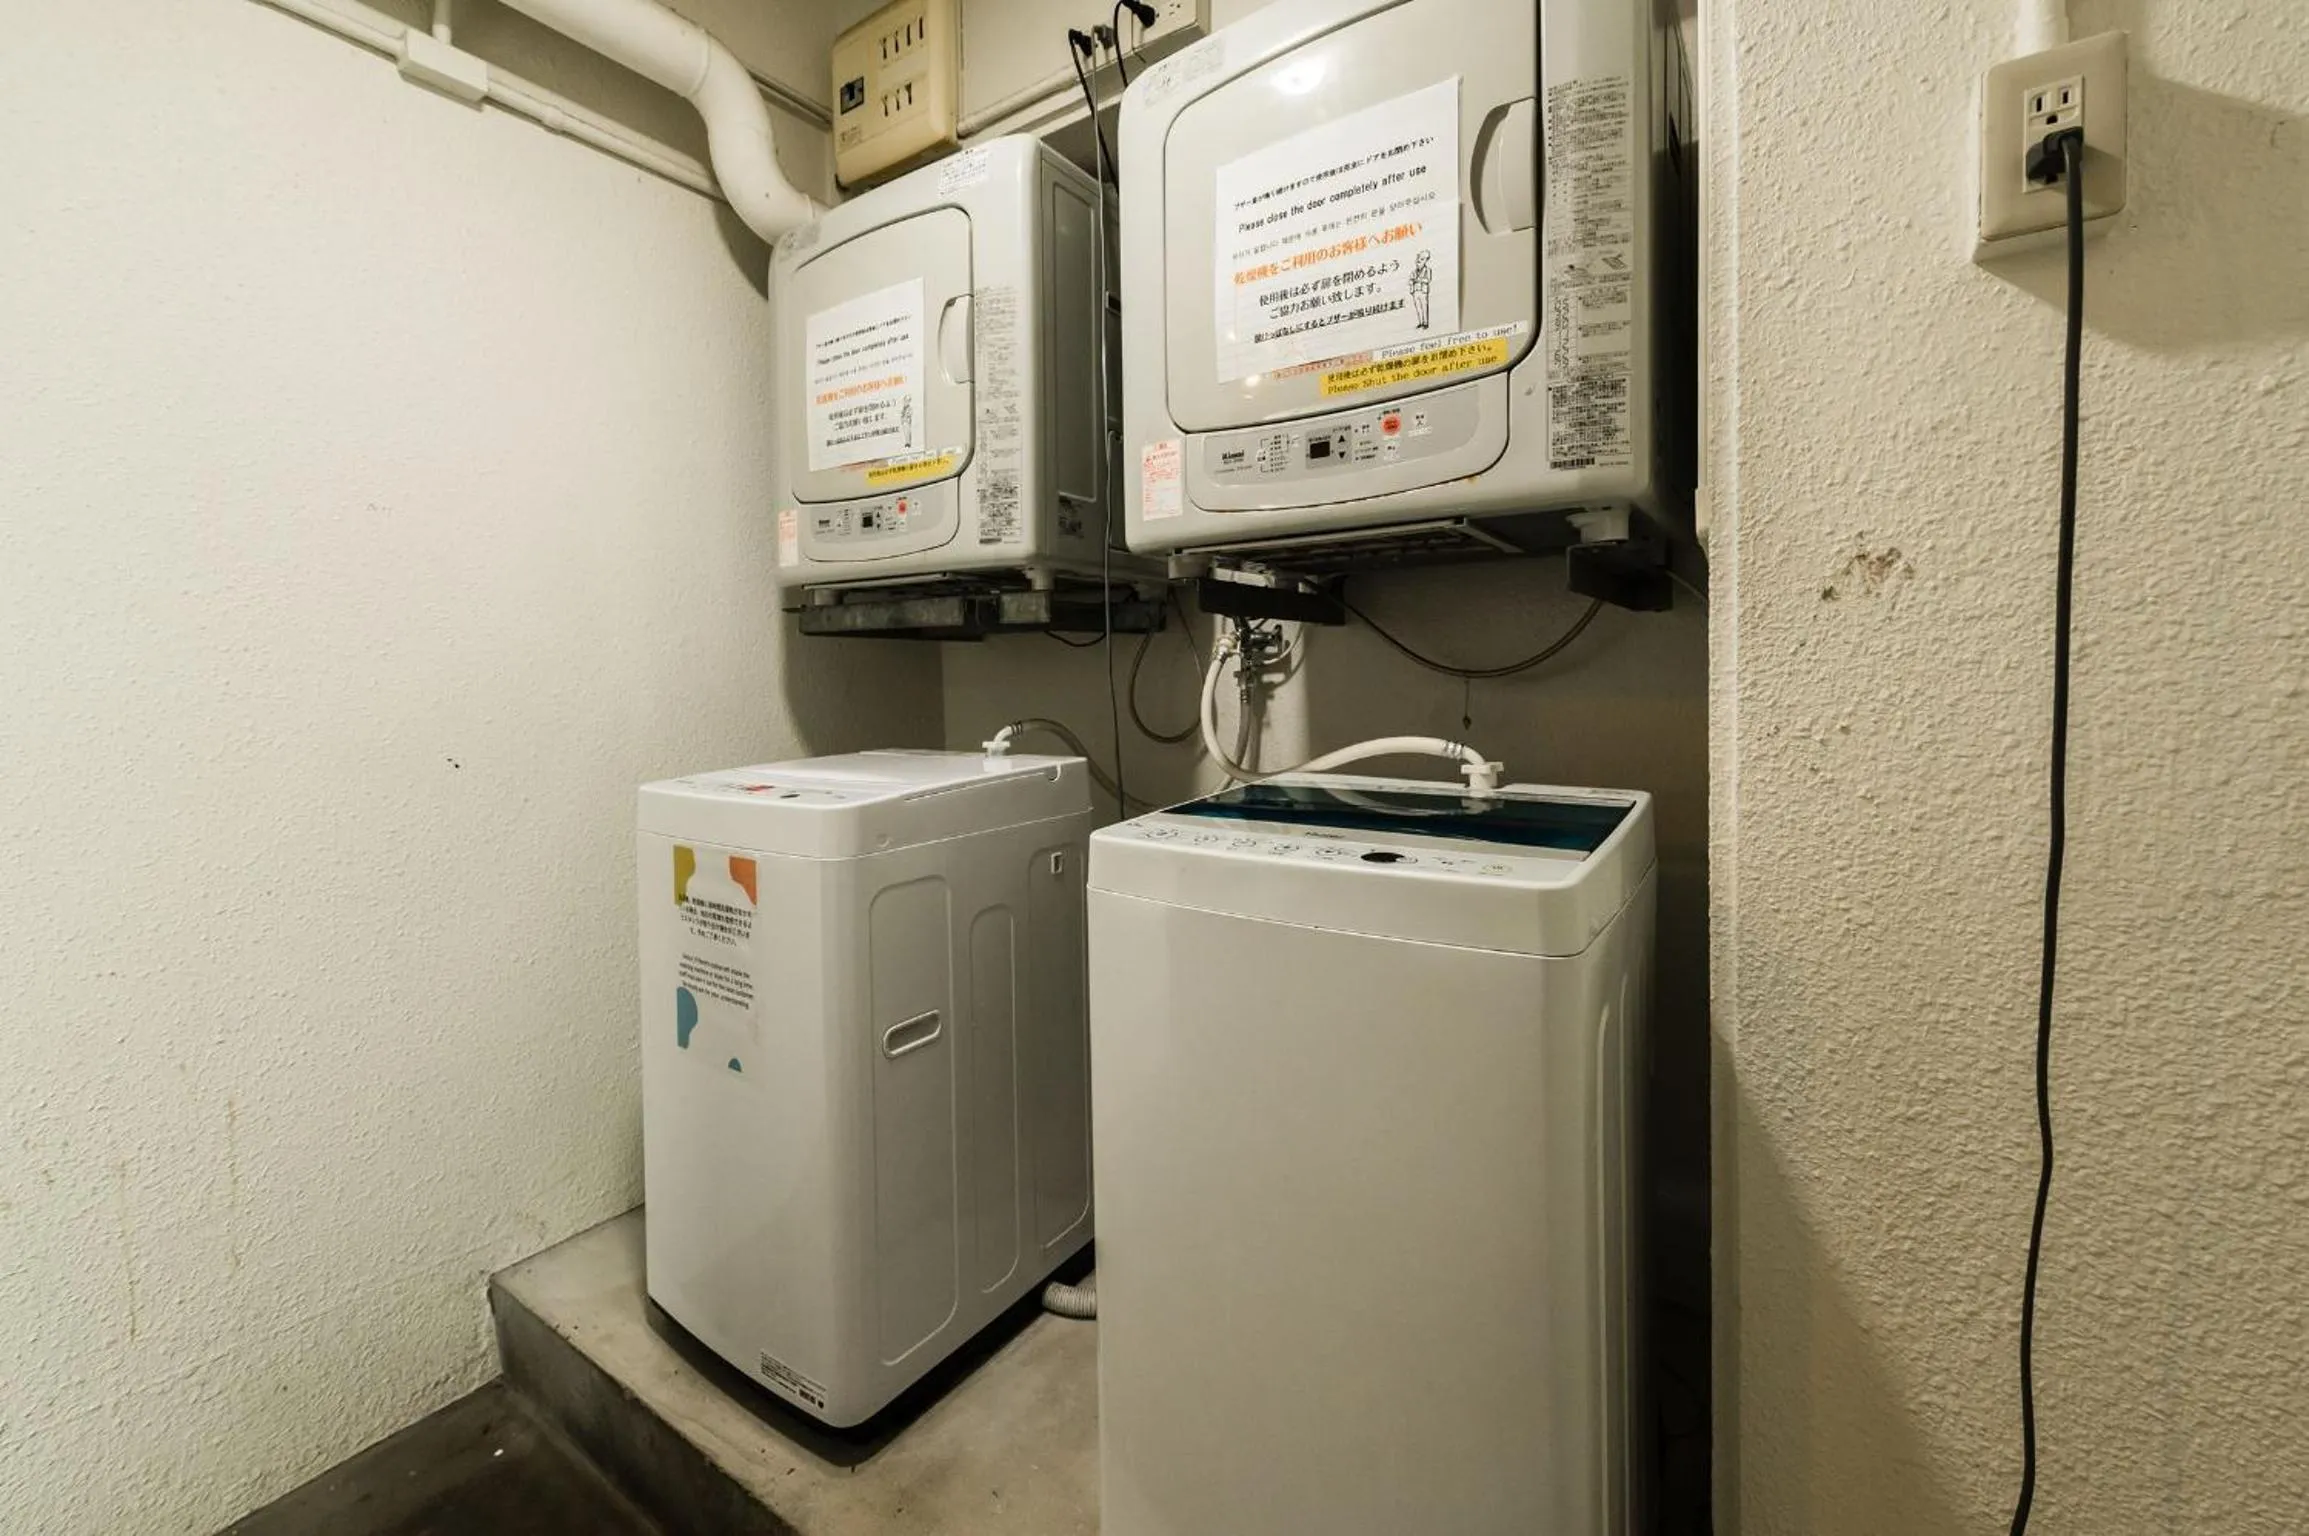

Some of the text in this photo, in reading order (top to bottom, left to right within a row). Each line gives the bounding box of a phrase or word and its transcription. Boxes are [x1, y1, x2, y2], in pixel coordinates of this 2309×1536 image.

[1238, 165, 1427, 233] Please close the door completely after use
[1382, 345, 1415, 360] Please
[1447, 333, 1472, 346] free
[1477, 329, 1488, 339] to
[1328, 381, 1359, 395] Please
[1392, 371, 1409, 383] the
[1413, 365, 1437, 378] door
[1442, 359, 1473, 373] after
[1479, 354, 1498, 366] use
